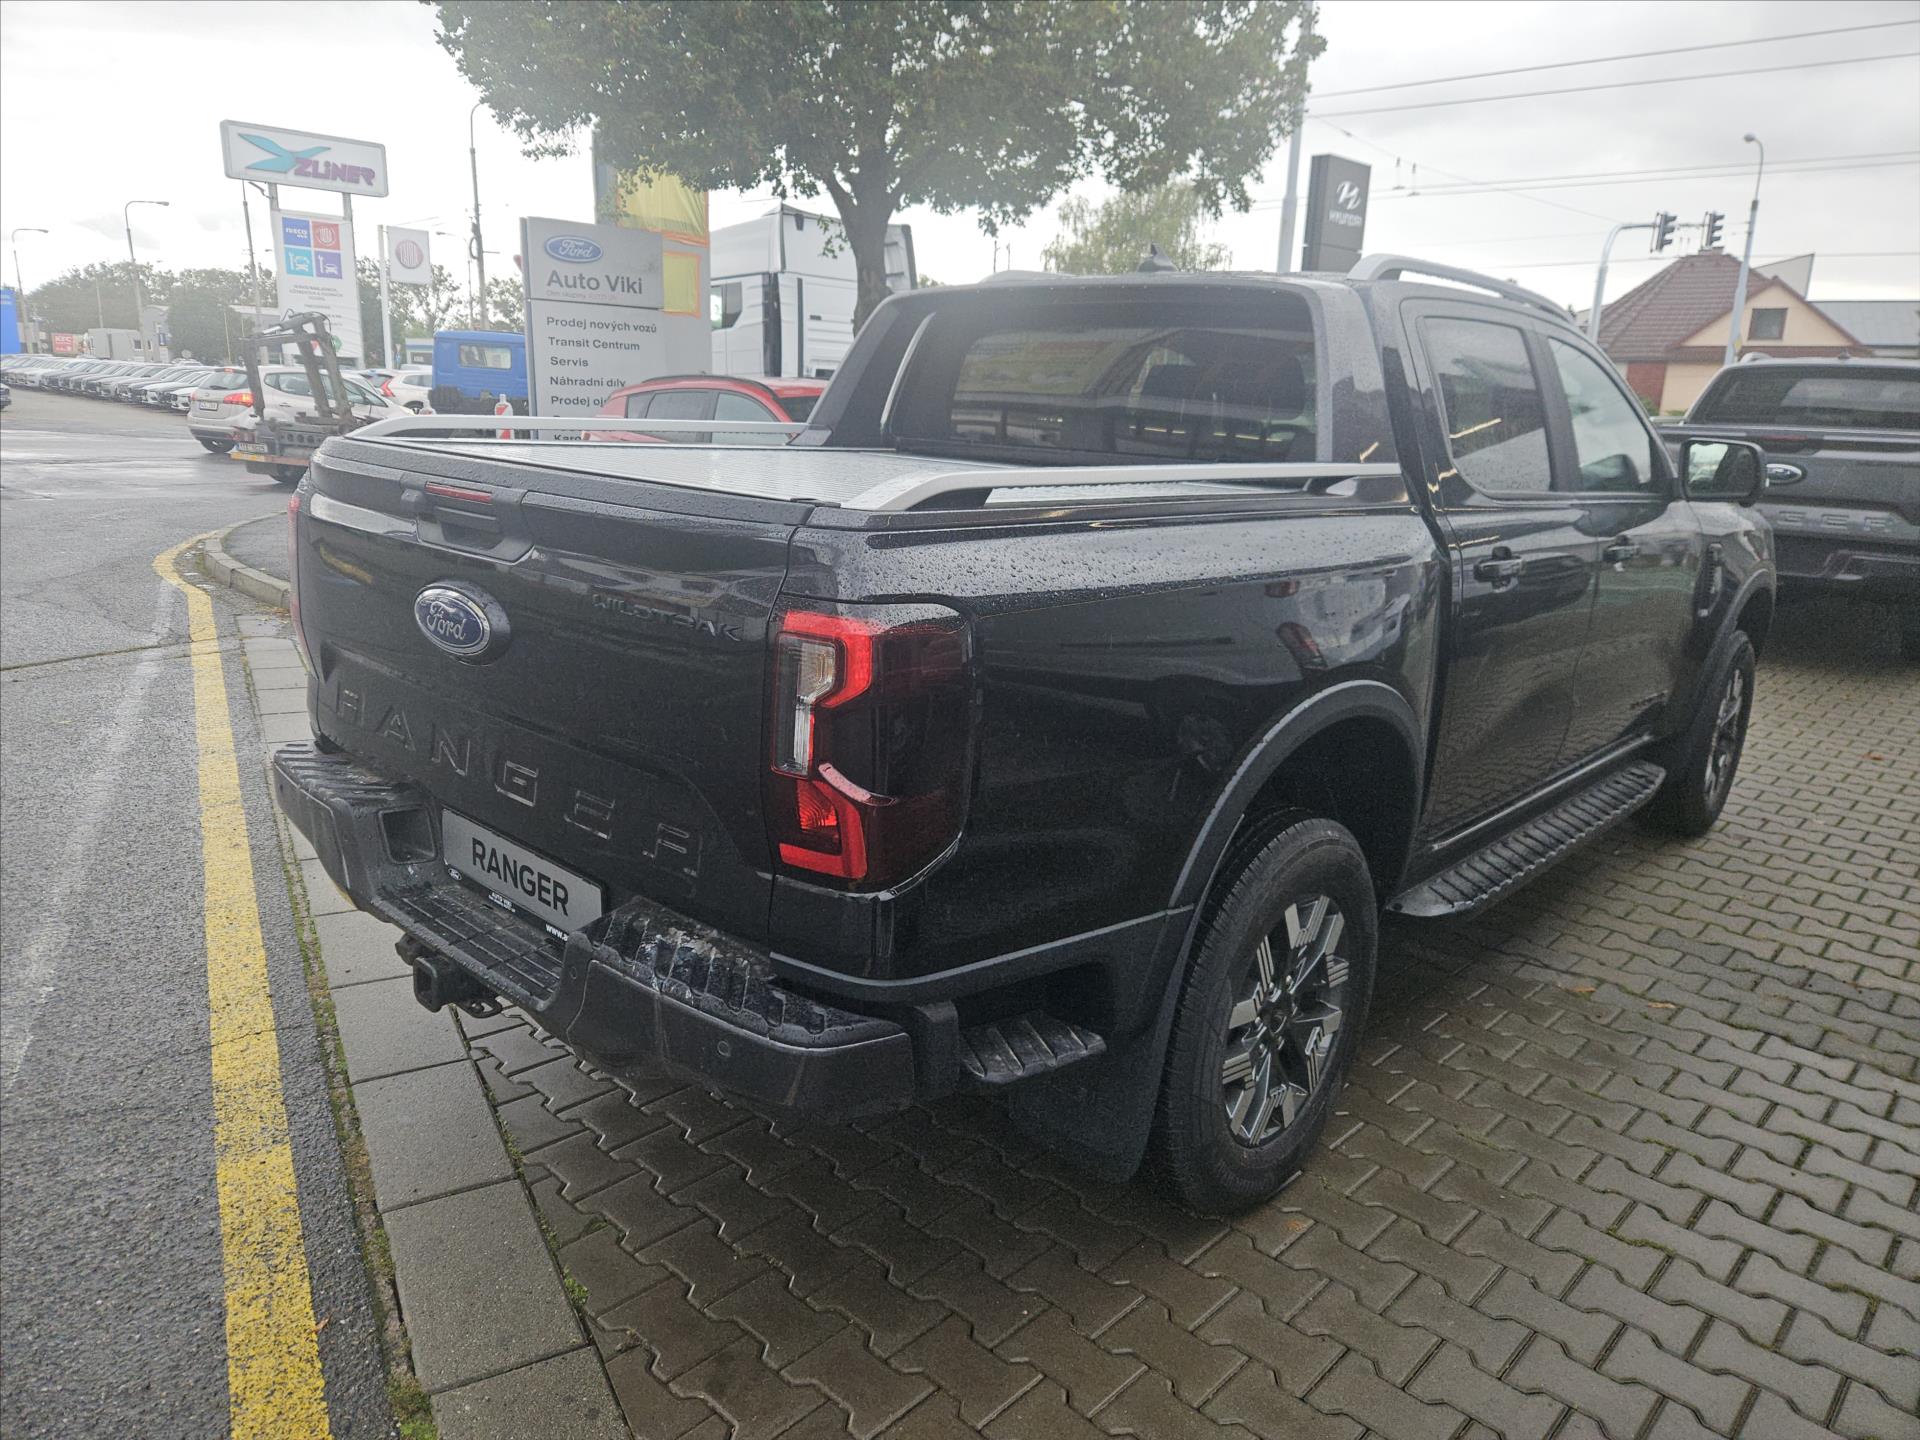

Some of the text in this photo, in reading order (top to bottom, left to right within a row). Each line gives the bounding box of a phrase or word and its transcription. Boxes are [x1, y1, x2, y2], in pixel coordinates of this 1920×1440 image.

[558, 239, 594, 258] Ford
[547, 269, 643, 294] Auto Viki
[546, 316, 657, 333] Prodej nových vozů
[548, 336, 641, 351] Transit Centrum
[550, 356, 589, 367] Servis
[550, 376, 604, 387] Náhradní
[551, 395, 590, 408] Prodej
[426, 600, 467, 641] Ford
[472, 837, 569, 917] RANGER
